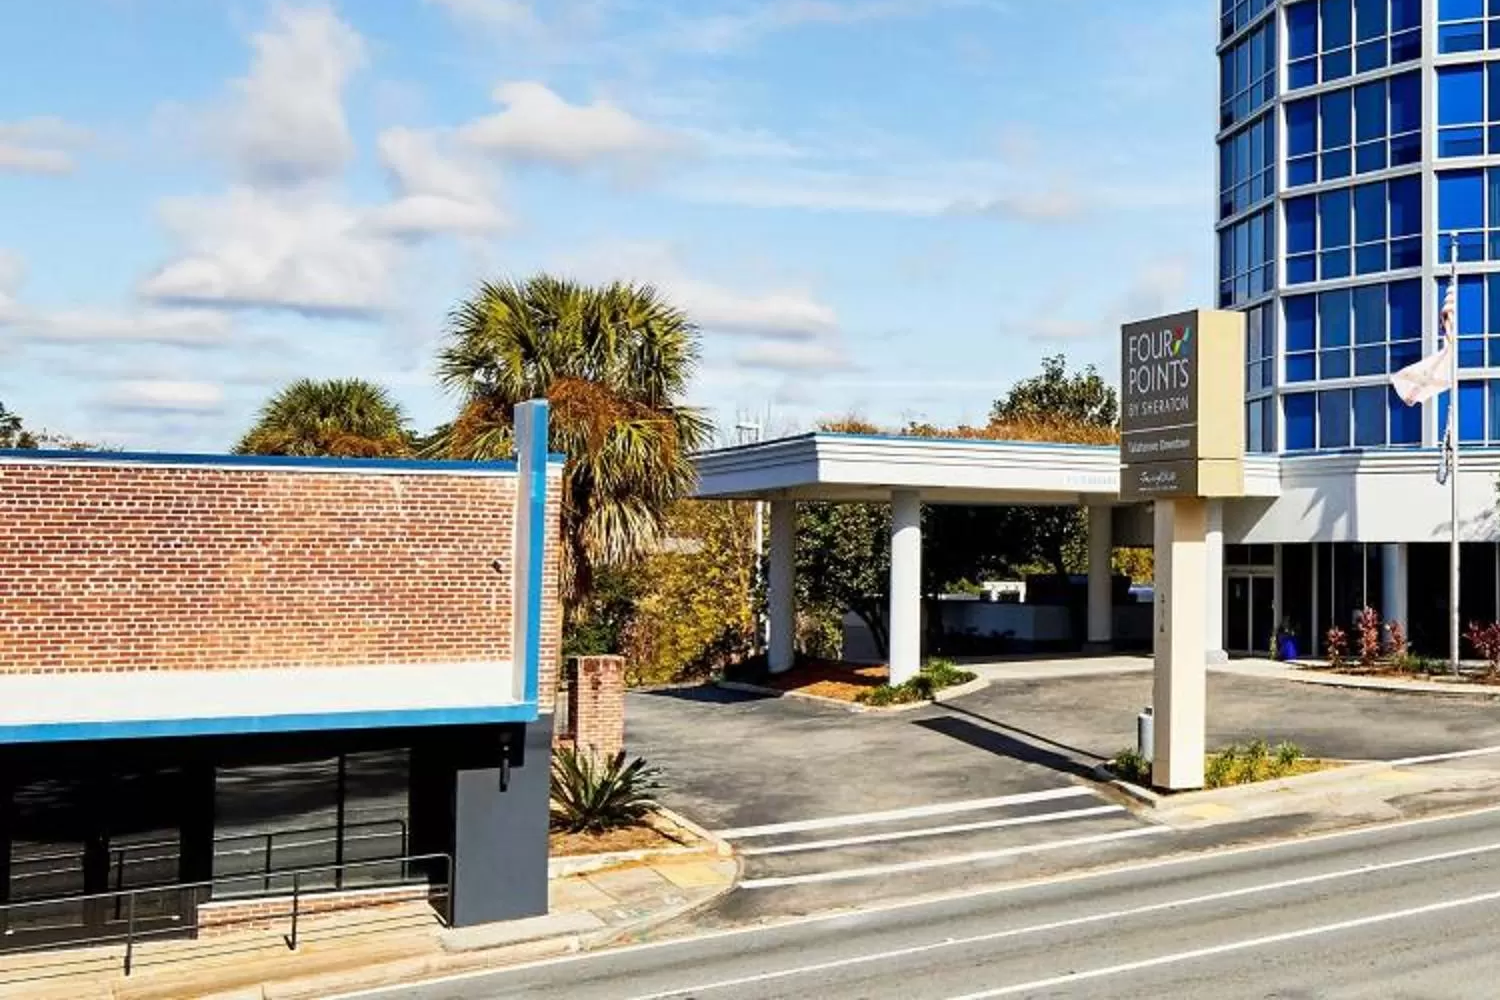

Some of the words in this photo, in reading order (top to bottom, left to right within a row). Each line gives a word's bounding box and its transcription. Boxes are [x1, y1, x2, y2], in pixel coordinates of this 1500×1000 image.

[1129, 329, 1173, 364] FOUR
[1129, 358, 1189, 395] POINTS
[1142, 394, 1189, 416] SHERATON
